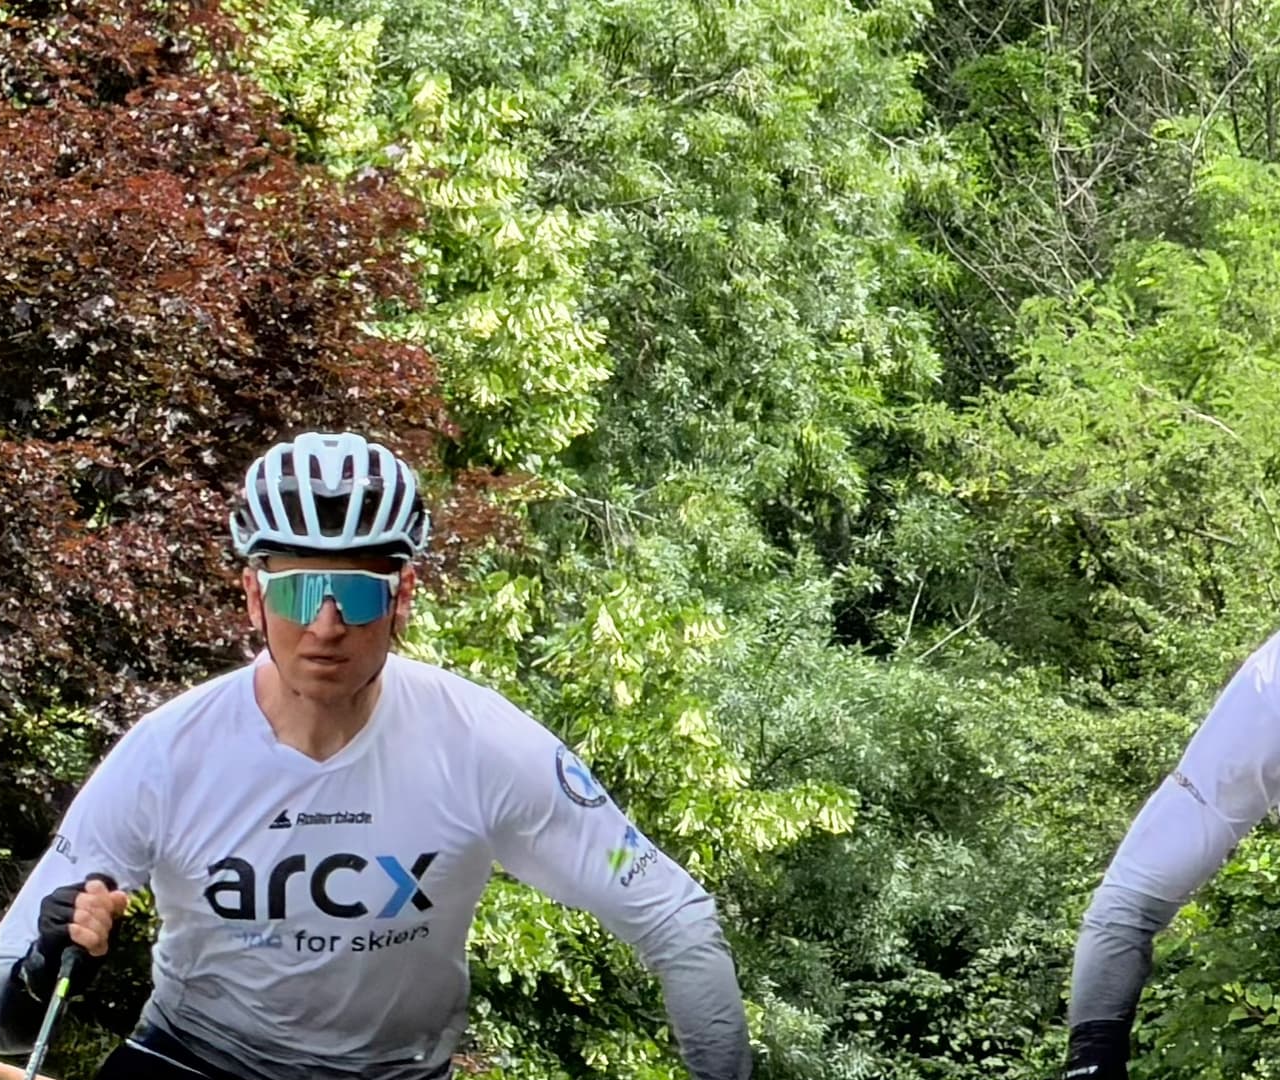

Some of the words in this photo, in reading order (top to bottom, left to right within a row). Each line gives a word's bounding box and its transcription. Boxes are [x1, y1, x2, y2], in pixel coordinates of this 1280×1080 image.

[296, 812, 372, 825] Rollerblade
[204, 852, 439, 920] arcx
[295, 930, 341, 952] for
[351, 924, 430, 952] skiers
